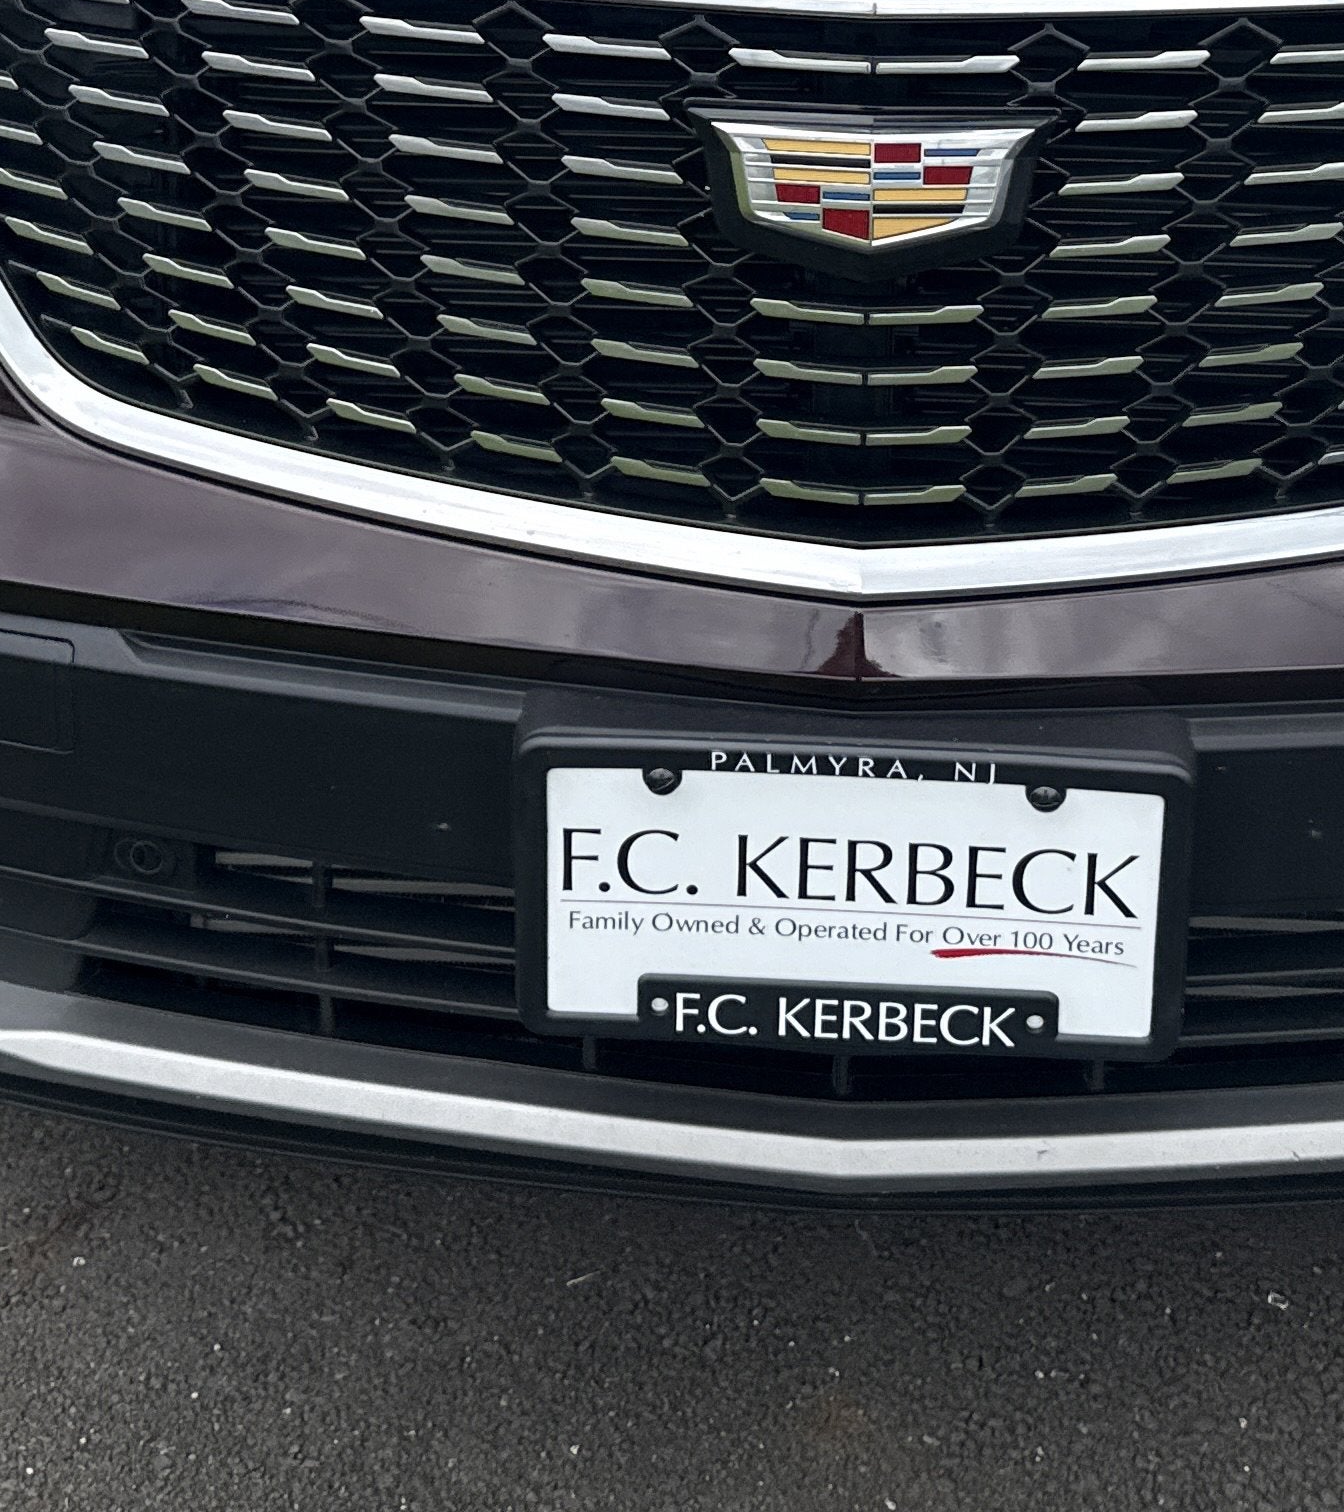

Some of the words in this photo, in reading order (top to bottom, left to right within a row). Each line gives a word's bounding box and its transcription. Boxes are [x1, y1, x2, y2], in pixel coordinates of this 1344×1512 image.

[710, 751, 925, 782] PALMYRA,
[954, 761, 1000, 785] NJ
[561, 828, 699, 896] F.C.
[736, 834, 1139, 920] KERBECK
[568, 910, 644, 935] Family
[651, 912, 740, 935] Owned
[748, 917, 766, 936] &
[774, 918, 887, 943] Operated
[895, 924, 934, 944] For
[942, 926, 1002, 949] Over
[1010, 931, 1054, 951] 100
[1063, 934, 1125, 956] Years
[673, 992, 758, 1036] F.C.
[777, 996, 1017, 1048] KERBECK
